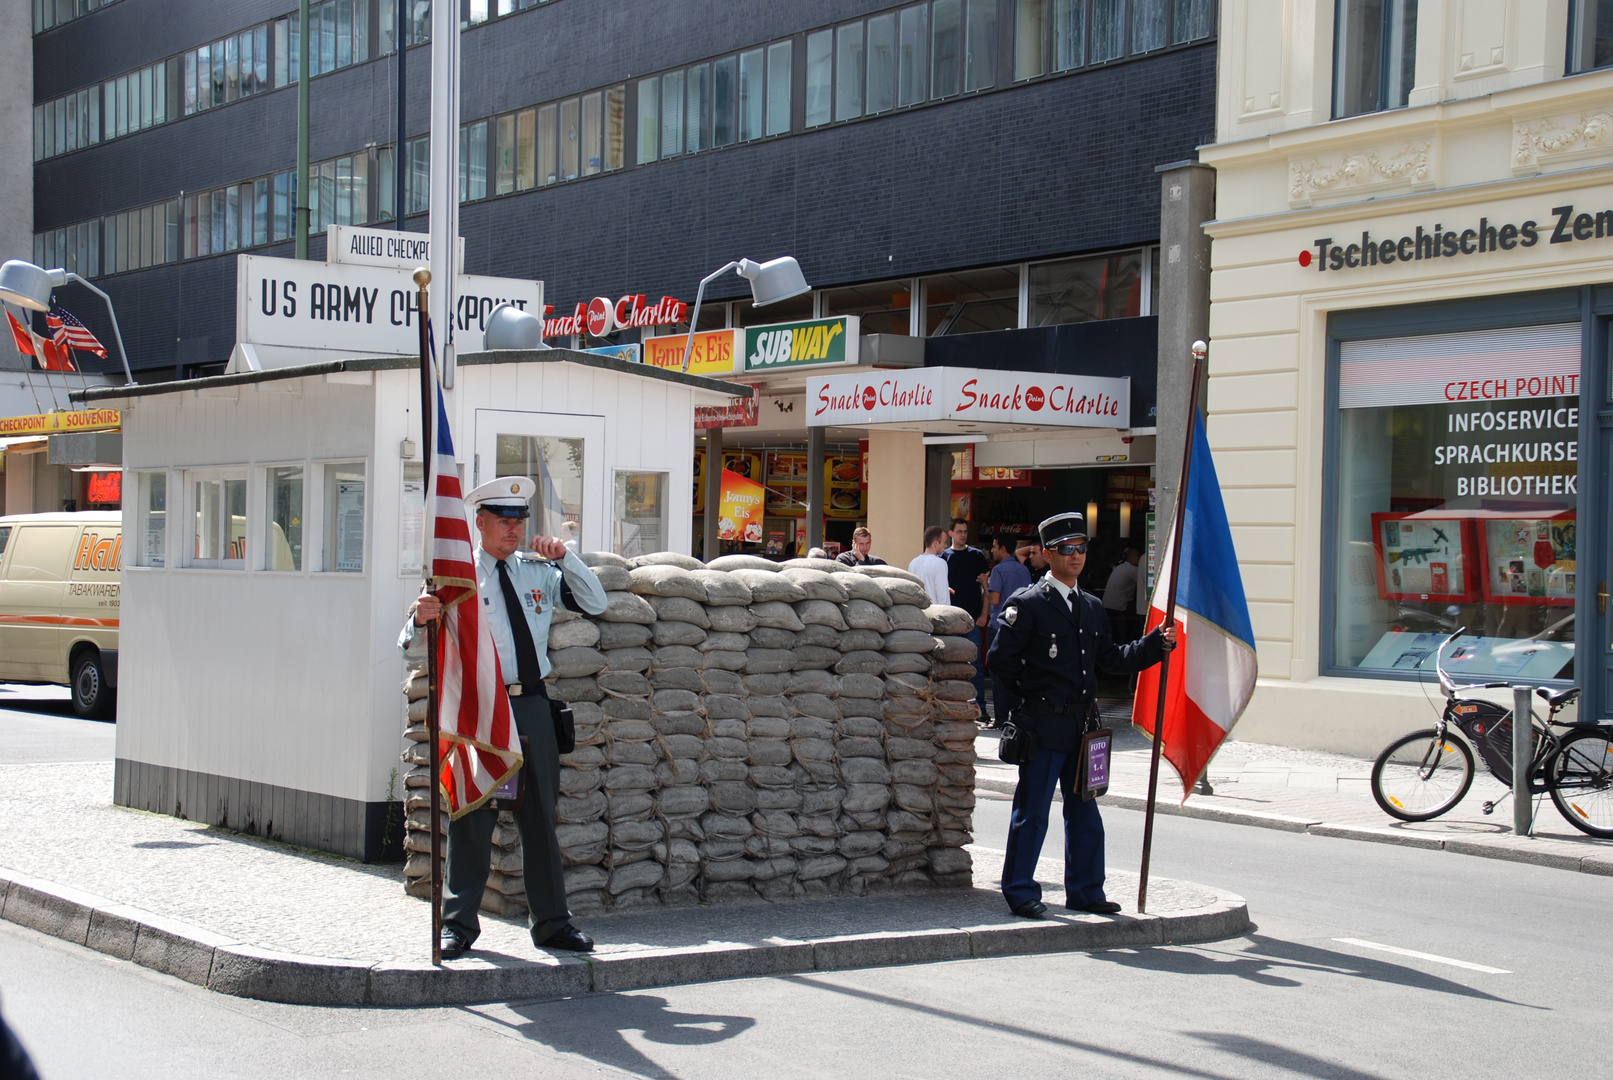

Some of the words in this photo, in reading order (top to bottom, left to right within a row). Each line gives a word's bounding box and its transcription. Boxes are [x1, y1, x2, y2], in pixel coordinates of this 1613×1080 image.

[350, 234, 383, 257] ALLIED
[1314, 217, 1539, 272] Tschechisches
[262, 279, 297, 318] US
[311, 282, 379, 324] ARMY
[543, 303, 587, 338] nack
[588, 310, 606, 325] Point
[614, 294, 687, 329] Charlie
[706, 335, 731, 363] Eis
[750, 320, 843, 367] SUBWAY
[814, 383, 860, 416] Snack
[879, 380, 933, 407] Charlie
[956, 379, 1022, 412] Snack
[1026, 393, 1045, 404] Point
[1049, 385, 1119, 416] Charlie
[1444, 379, 1507, 401] CZECH
[1516, 374, 1580, 397] POINT
[0, 416, 46, 432] CHECKPOINT
[66, 410, 119, 427] SOUVENIRS
[1448, 408, 1579, 433] INFOSERVICE
[1434, 441, 1578, 465] SPRACHKURSE
[724, 490, 761, 507] Janny's
[1457, 475, 1578, 497] BIBLIOTHEK
[734, 506, 750, 519] Eis
[1090, 741, 1106, 752] FOTO
